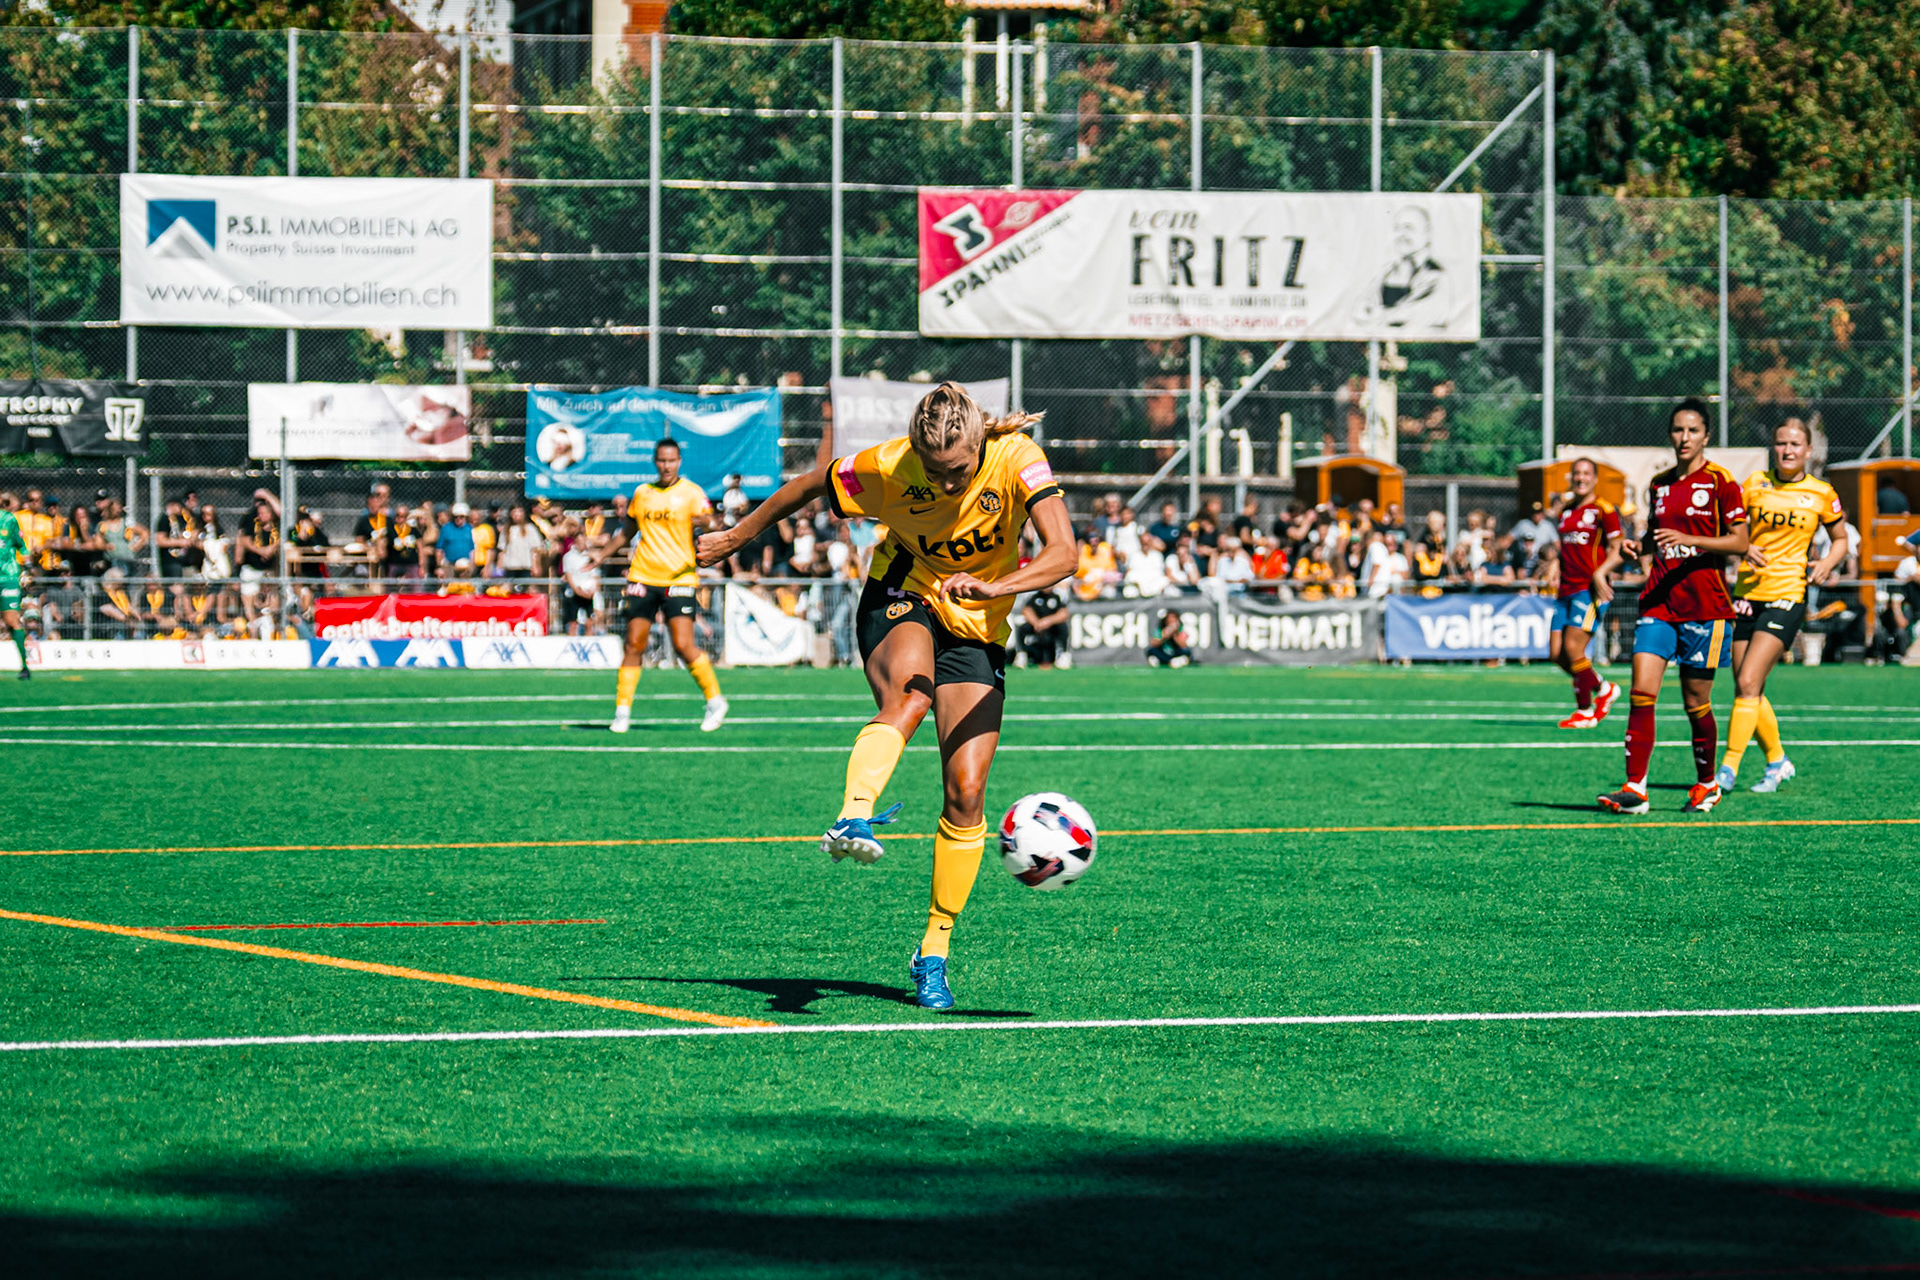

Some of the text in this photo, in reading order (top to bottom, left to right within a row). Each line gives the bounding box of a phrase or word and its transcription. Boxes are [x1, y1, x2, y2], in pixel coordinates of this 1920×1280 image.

[227, 216, 459, 237] P.S.I. IMMOBILIEN AG
[226, 240, 415, 257] Property Suisse Investment
[1131, 234, 1307, 290] FRITZ
[146, 280, 458, 309] www.psiimmobilien.ch
[0, 396, 84, 415] TROPHY
[901, 485, 936, 502] AXA
[1757, 506, 1806, 528] kpt:
[917, 523, 1005, 561] kpt:
[1071, 608, 1362, 651] ISCH SI HEIMAT!
